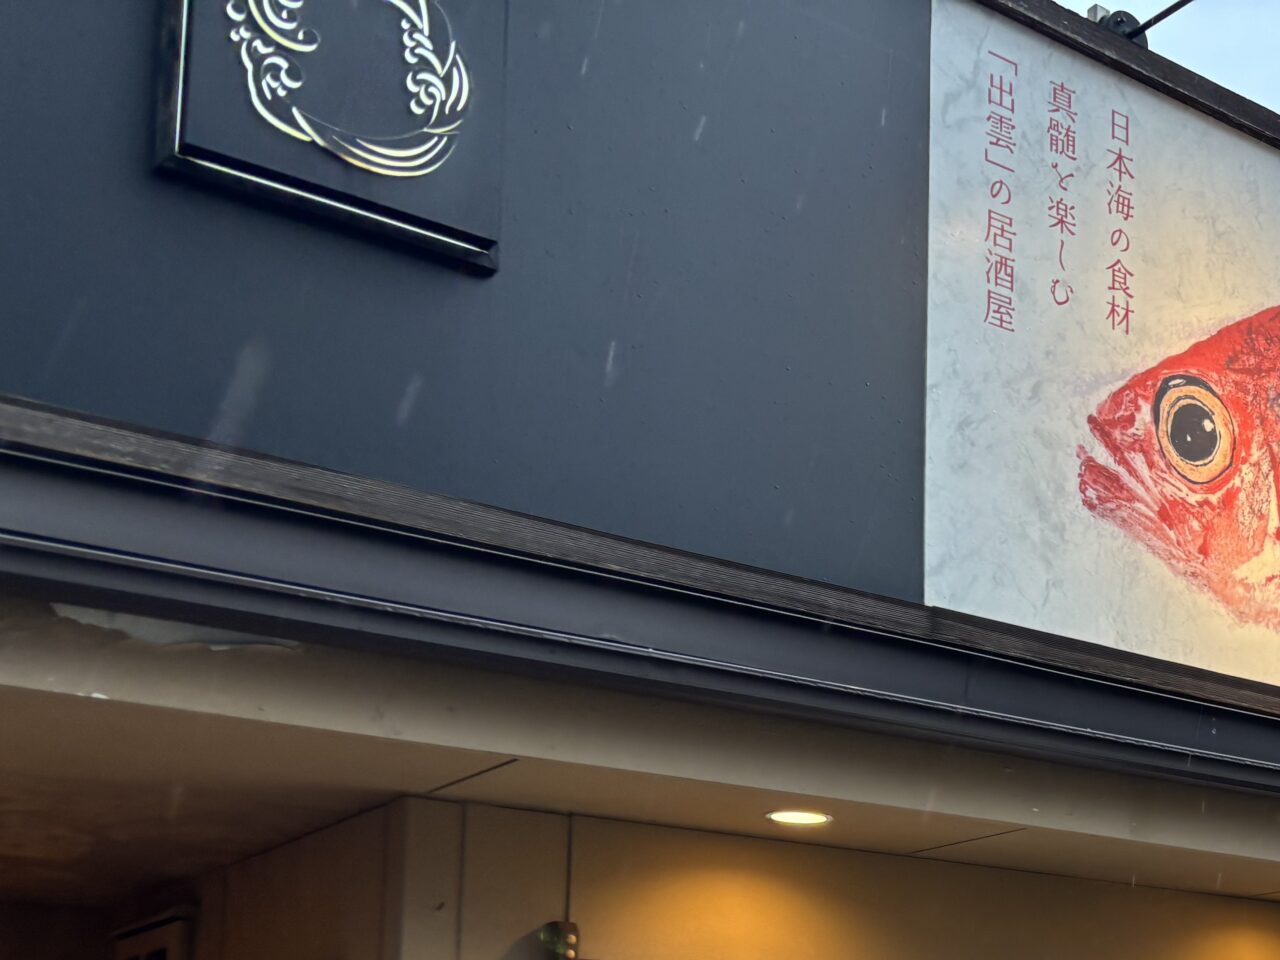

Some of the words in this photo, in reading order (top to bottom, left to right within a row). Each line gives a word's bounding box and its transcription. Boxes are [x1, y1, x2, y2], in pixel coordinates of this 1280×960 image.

[984, 50, 1018, 332] 「出雲」の居酒屋
[1047, 81, 1077, 306] 真髄と楽しむ
[1106, 109, 1135, 335] 日本海の食材
